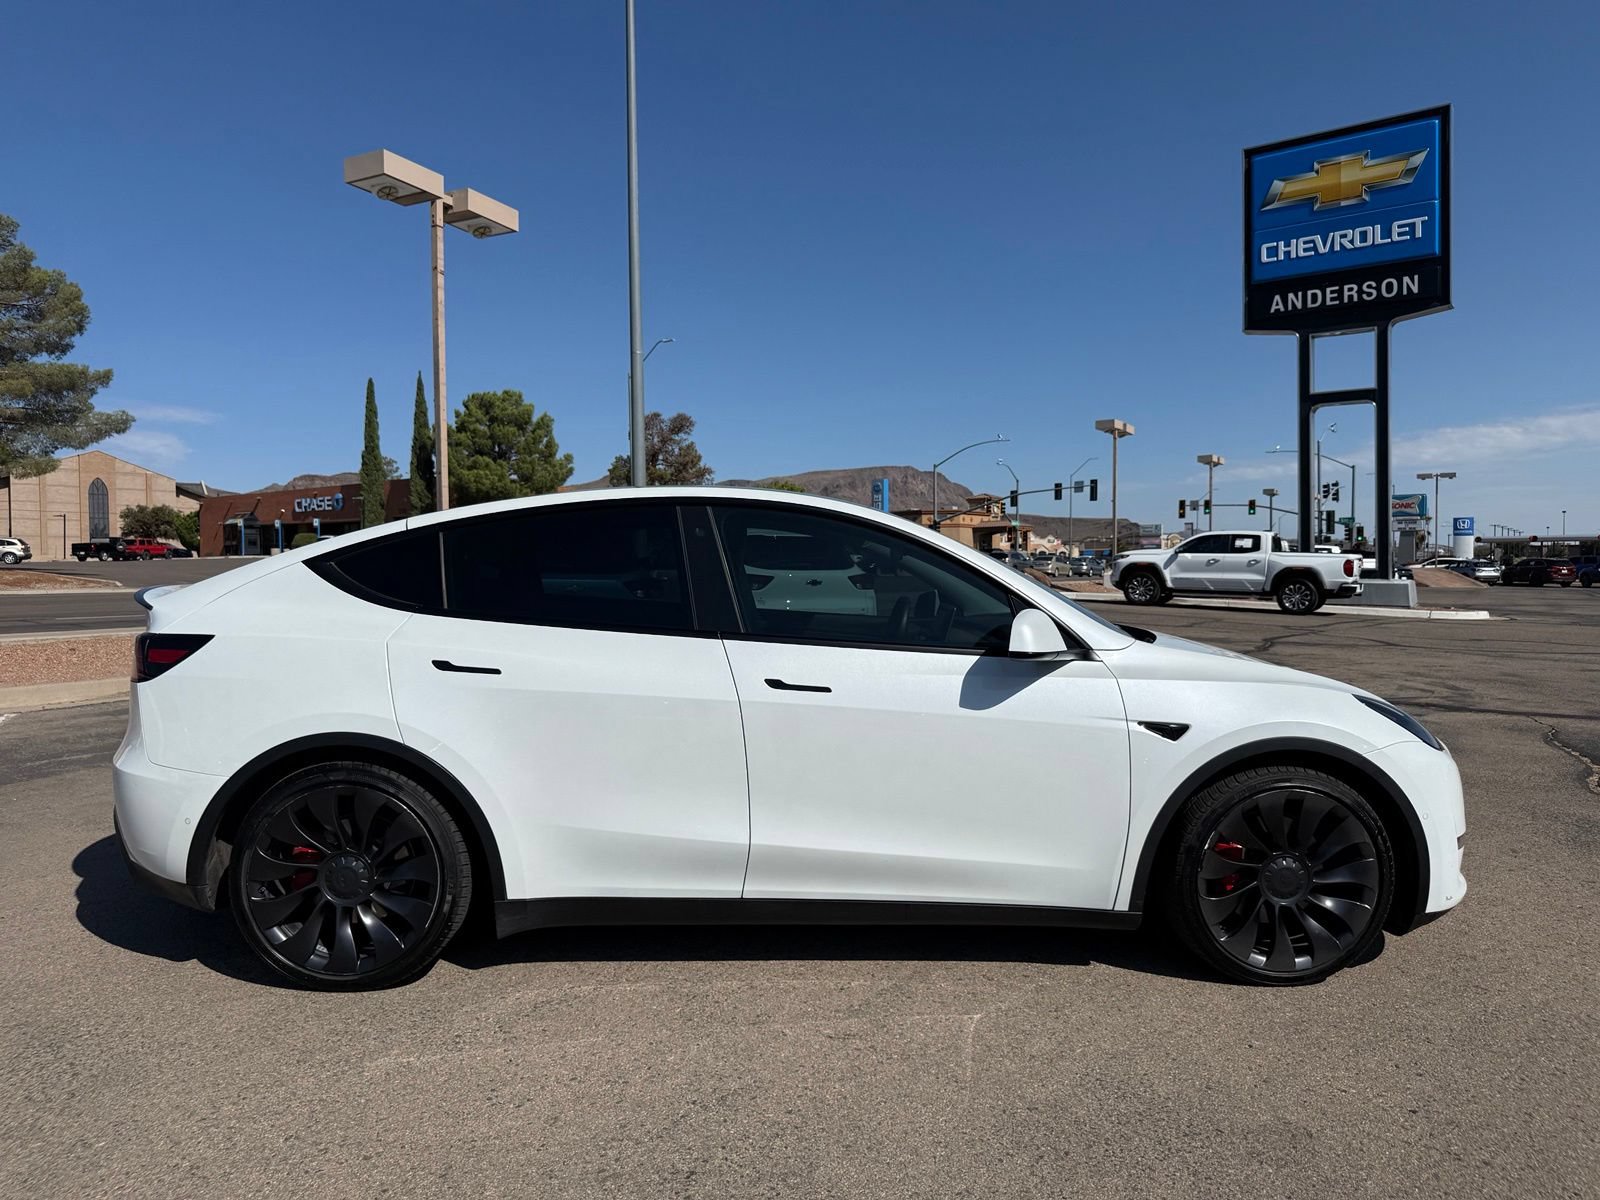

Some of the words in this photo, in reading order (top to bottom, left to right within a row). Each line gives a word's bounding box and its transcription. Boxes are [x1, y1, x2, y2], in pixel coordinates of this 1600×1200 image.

[1260, 216, 1428, 263] CHEVROLET
[1270, 274, 1419, 313] ANDERSON
[294, 496, 333, 512] CHASE
